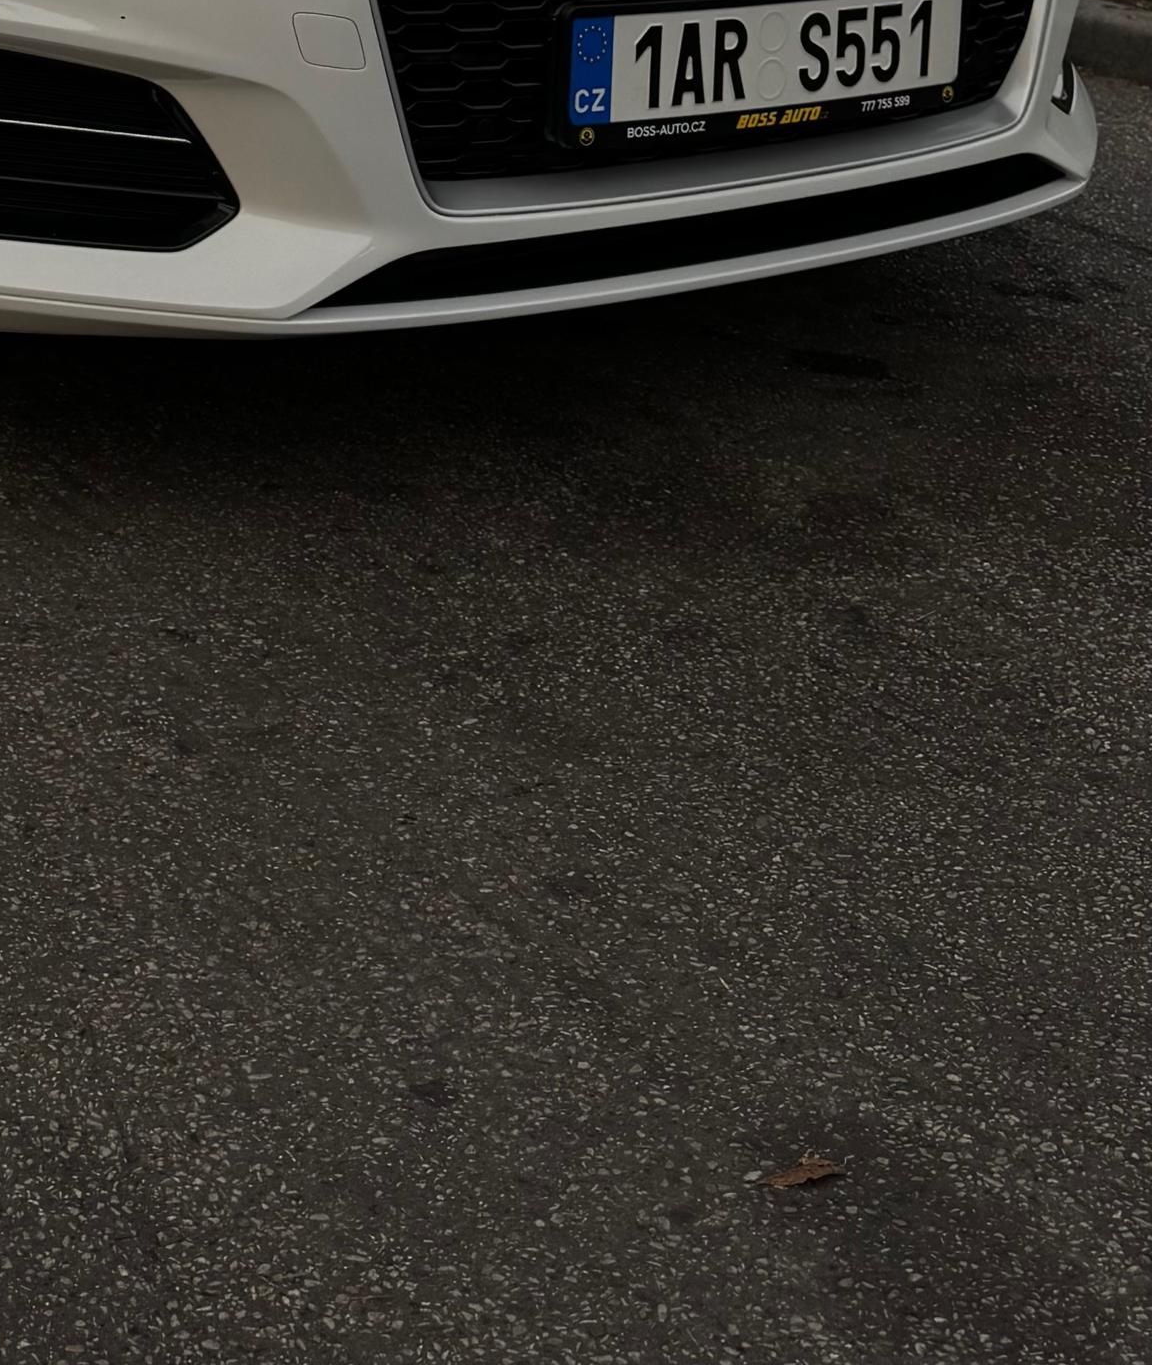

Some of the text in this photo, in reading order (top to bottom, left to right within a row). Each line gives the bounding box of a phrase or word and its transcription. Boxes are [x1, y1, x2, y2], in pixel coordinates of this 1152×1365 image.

[634, 0, 933, 109] 1AR S551
[574, 88, 606, 114] CZ
[861, 100, 876, 112] 777
[735, 111, 778, 129] BOSS
[627, 121, 706, 138] BOSS-AUTO.CZ
